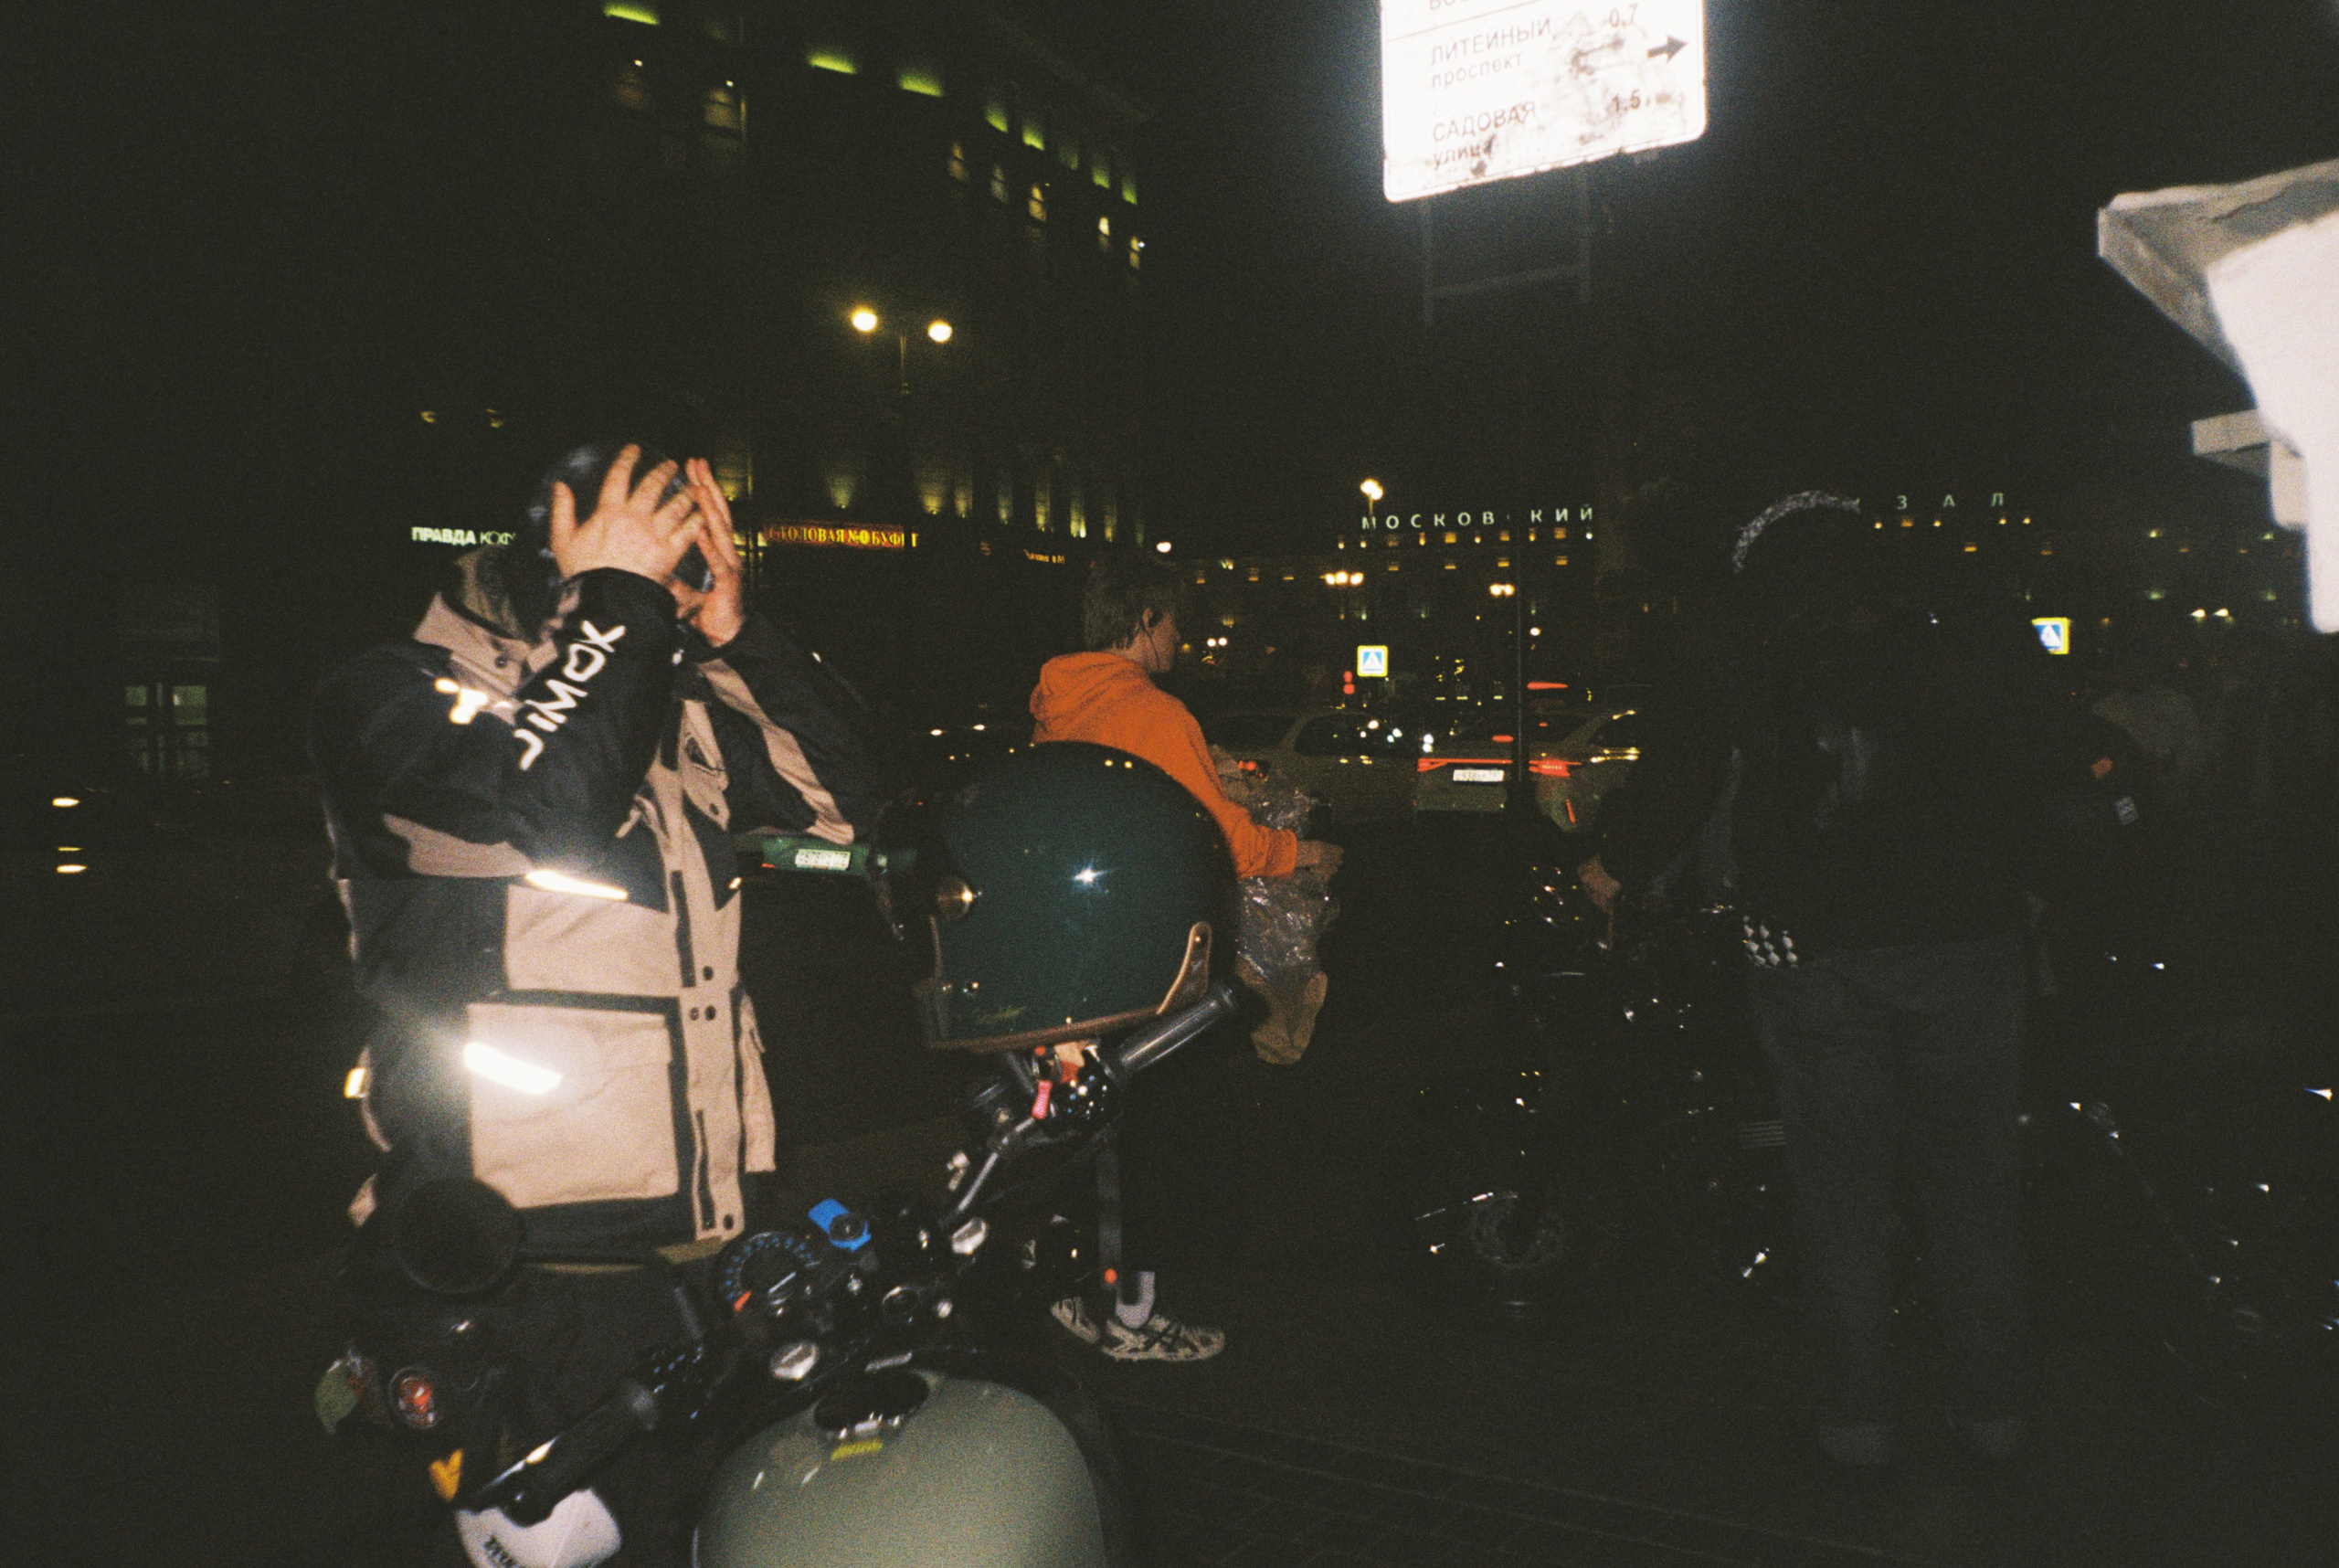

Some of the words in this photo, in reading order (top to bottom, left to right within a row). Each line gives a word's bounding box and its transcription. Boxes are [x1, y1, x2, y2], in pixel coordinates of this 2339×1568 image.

[1431, 15, 1551, 66] ЛИТЕЙНЫЙ
[1432, 52, 1523, 90] проспект
[1433, 101, 1536, 143] САДОВАЯ
[1361, 504, 1593, 529] МОСКОВКИЙ
[411, 526, 476, 546] ПРАВДА
[481, 531, 516, 546] КОФ
